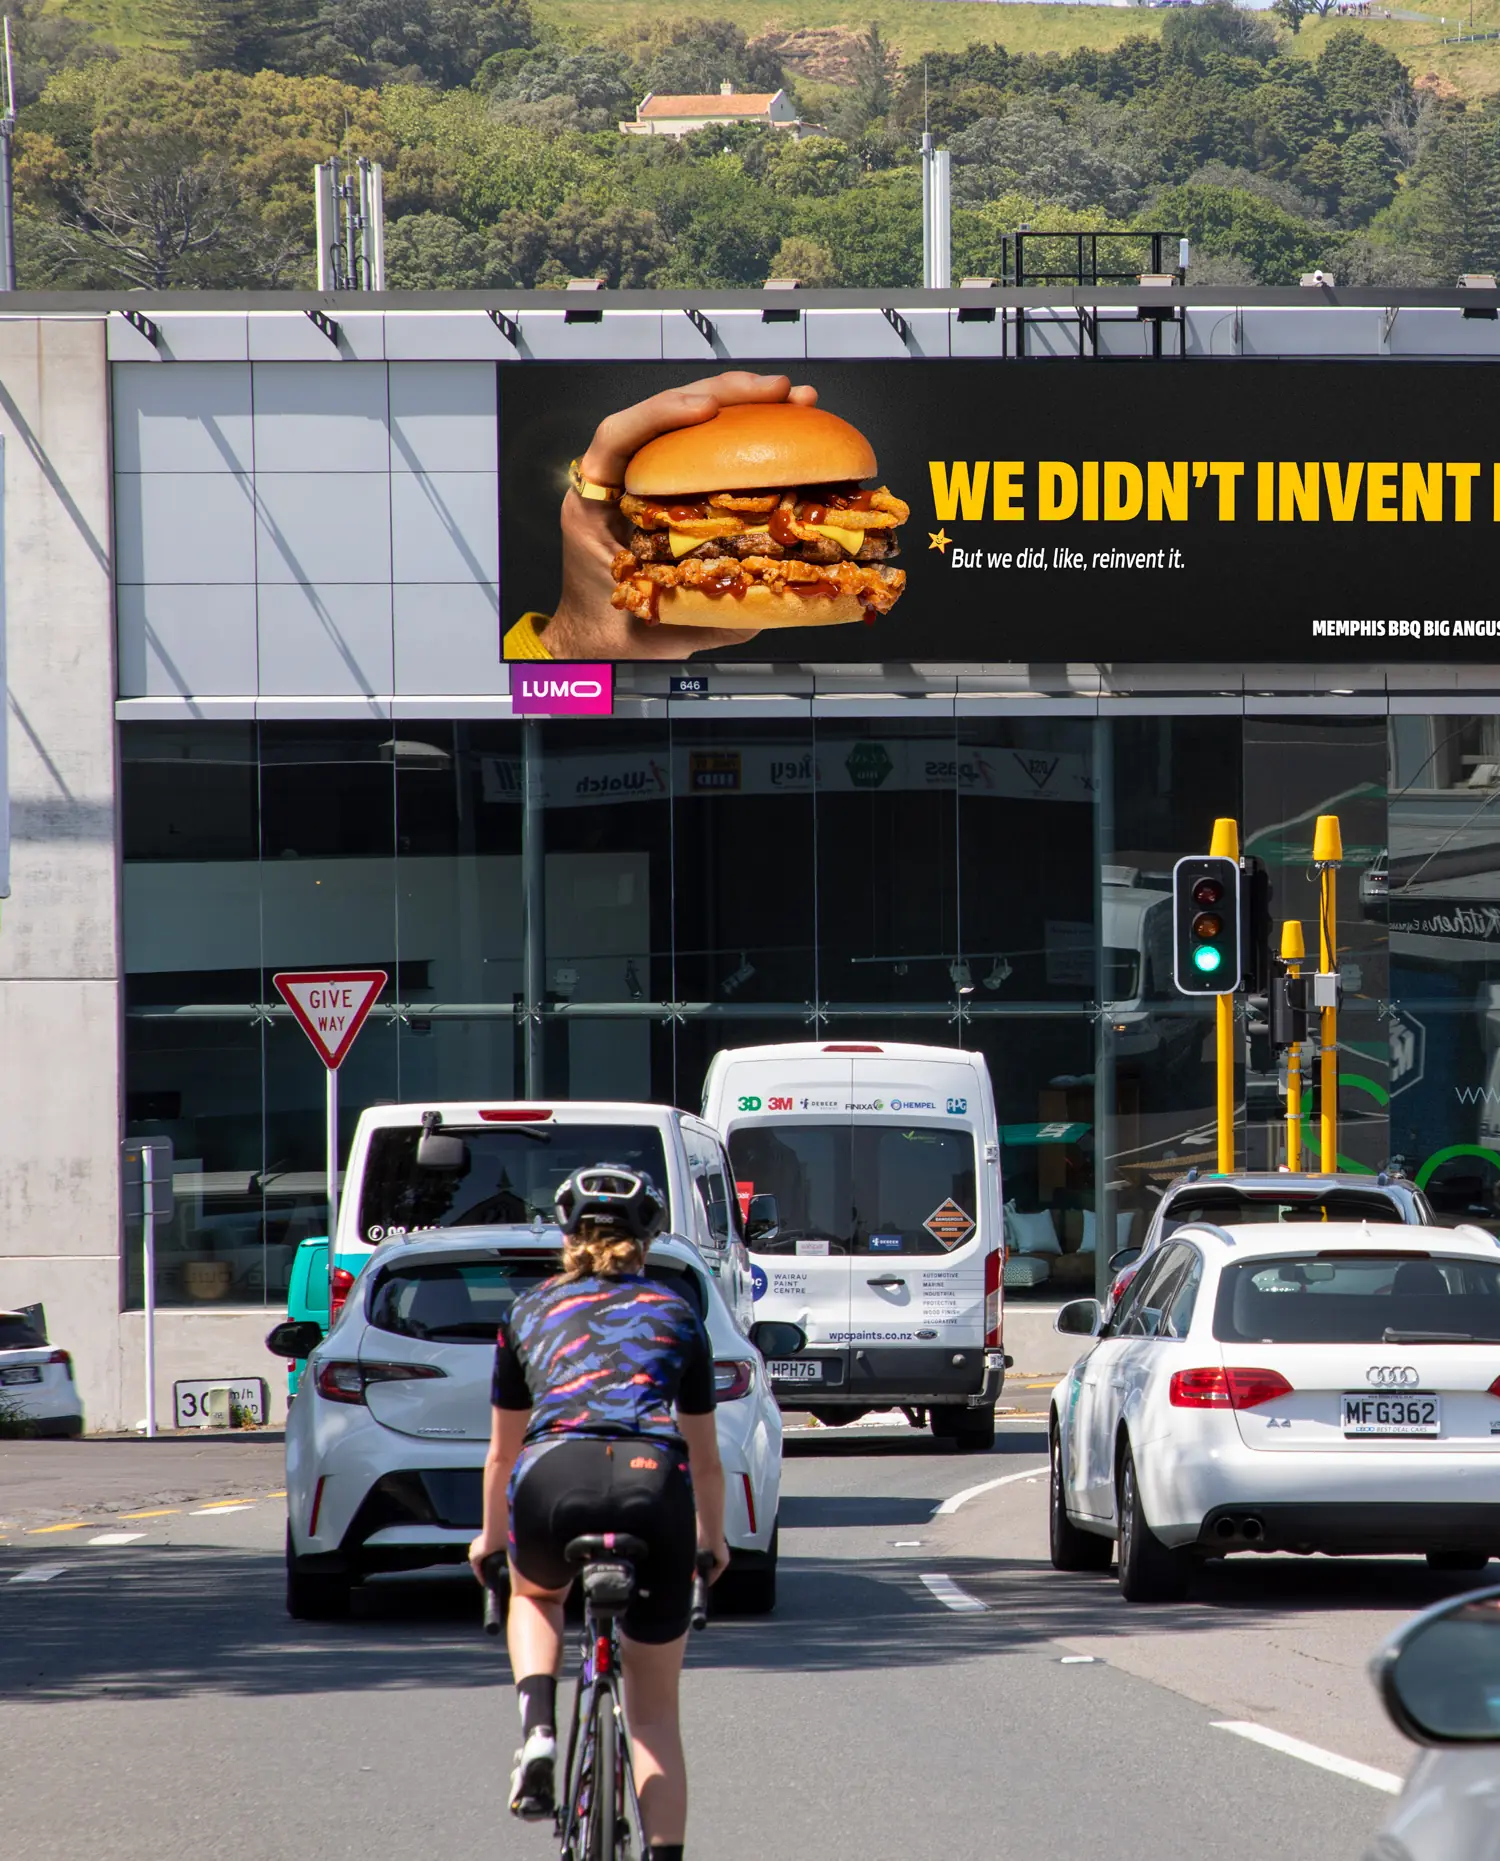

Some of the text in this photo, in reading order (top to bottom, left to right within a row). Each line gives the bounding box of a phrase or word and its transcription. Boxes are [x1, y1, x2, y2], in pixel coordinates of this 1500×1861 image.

[929, 461, 1025, 521] WE
[1038, 461, 1245, 521] DIDN'T
[1257, 461, 1480, 522] INVENT
[951, 548, 1185, 571] But we did, like, reinvent it.
[1312, 620, 1386, 637] MEMPHIS
[1388, 620, 1421, 639] BBQ
[1424, 620, 1450, 637] BIG
[522, 681, 602, 698] LUMO
[680, 681, 700, 690] 646
[309, 989, 353, 1009] GIVE
[318, 1016, 345, 1031] WAY
[737, 1096, 762, 1111] 3D
[768, 1096, 793, 1111] 3M
[947, 1098, 967, 1112] PPG
[829, 1330, 913, 1342] wpcpaints.co.nz
[772, 1363, 816, 1377] HPH76
[1346, 1401, 1436, 1425] MFG362
[629, 1456, 658, 1470] dhb
